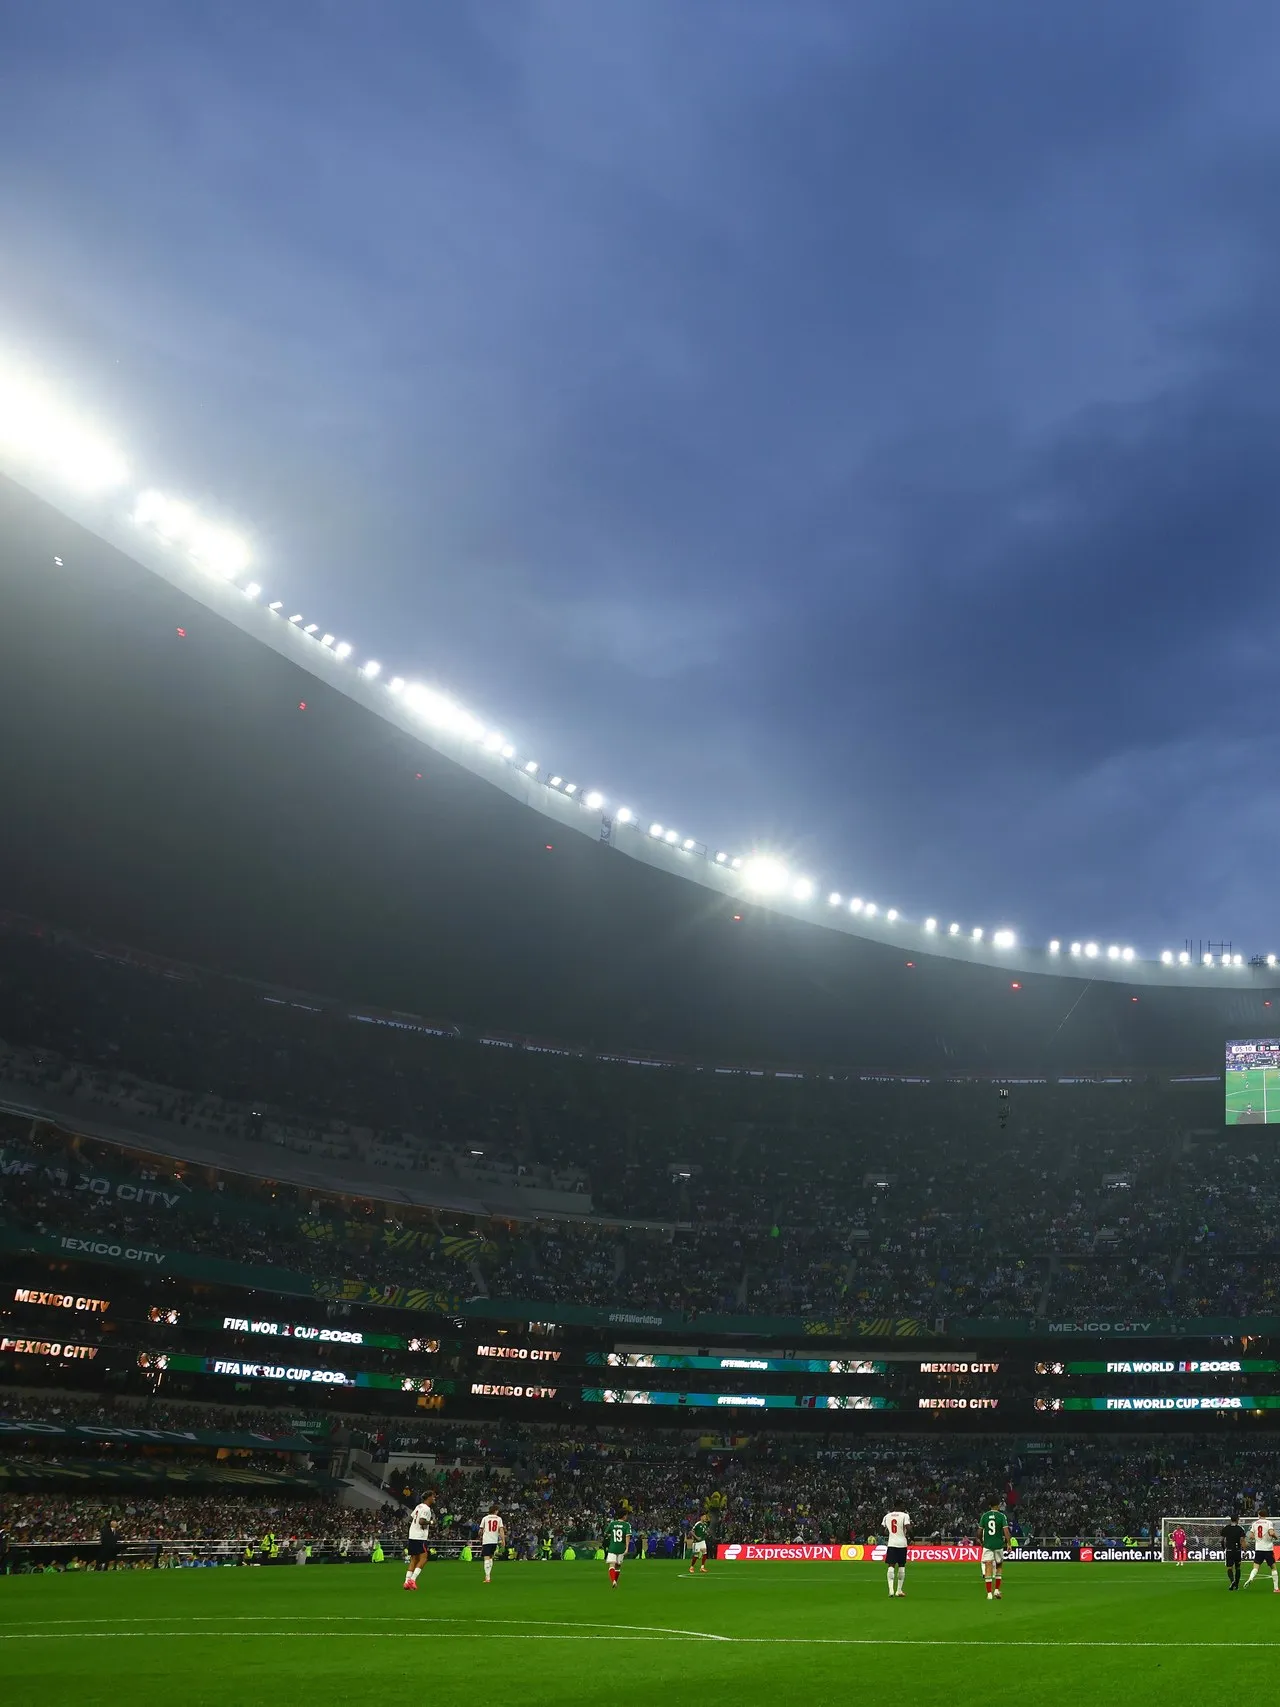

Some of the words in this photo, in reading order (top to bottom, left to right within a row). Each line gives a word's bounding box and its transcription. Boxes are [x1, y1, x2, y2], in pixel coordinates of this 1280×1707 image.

[116, 1184, 180, 1208] CITY
[125, 1248, 165, 1264] CITY
[14, 1289, 73, 1308] MEXICO
[76, 1298, 110, 1312] CITY
[608, 1313, 662, 1326] #FIFAWorldCup
[223, 1317, 248, 1331] FIFA
[294, 1326, 319, 1339] CUP
[319, 1329, 362, 1344] 2026
[1048, 1323, 1111, 1332] MEXICO
[64, 1344, 98, 1360] CITY
[477, 1345, 528, 1359] MEXICO
[530, 1350, 561, 1361] CITY
[214, 1361, 240, 1375] FIFA
[286, 1368, 310, 1381] CUP
[920, 1363, 968, 1373] MEXICO
[970, 1363, 999, 1373] CITY
[1107, 1362, 1131, 1373] FIFA
[1133, 1362, 1174, 1373] WORLD
[1200, 1361, 1241, 1372] 2026
[471, 1384, 522, 1397] MEXICO
[918, 1398, 967, 1409] MEXICO
[969, 1398, 999, 1409] CITY
[1107, 1399, 1131, 1409] FIFA
[1132, 1399, 1175, 1409] WORLD
[1176, 1399, 1199, 1409] CUP
[1200, 1398, 1242, 1408] 2026
[488, 1520, 498, 1532] 18
[891, 1519, 898, 1534] 6
[988, 1520, 996, 1536] 9
[1257, 1525, 1263, 1538] 8
[613, 1529, 623, 1542] 19
[746, 1546, 833, 1560] ExpressVPN
[907, 1547, 979, 1561] xpressVPN
[1003, 1549, 1071, 1560] caliente.mx
